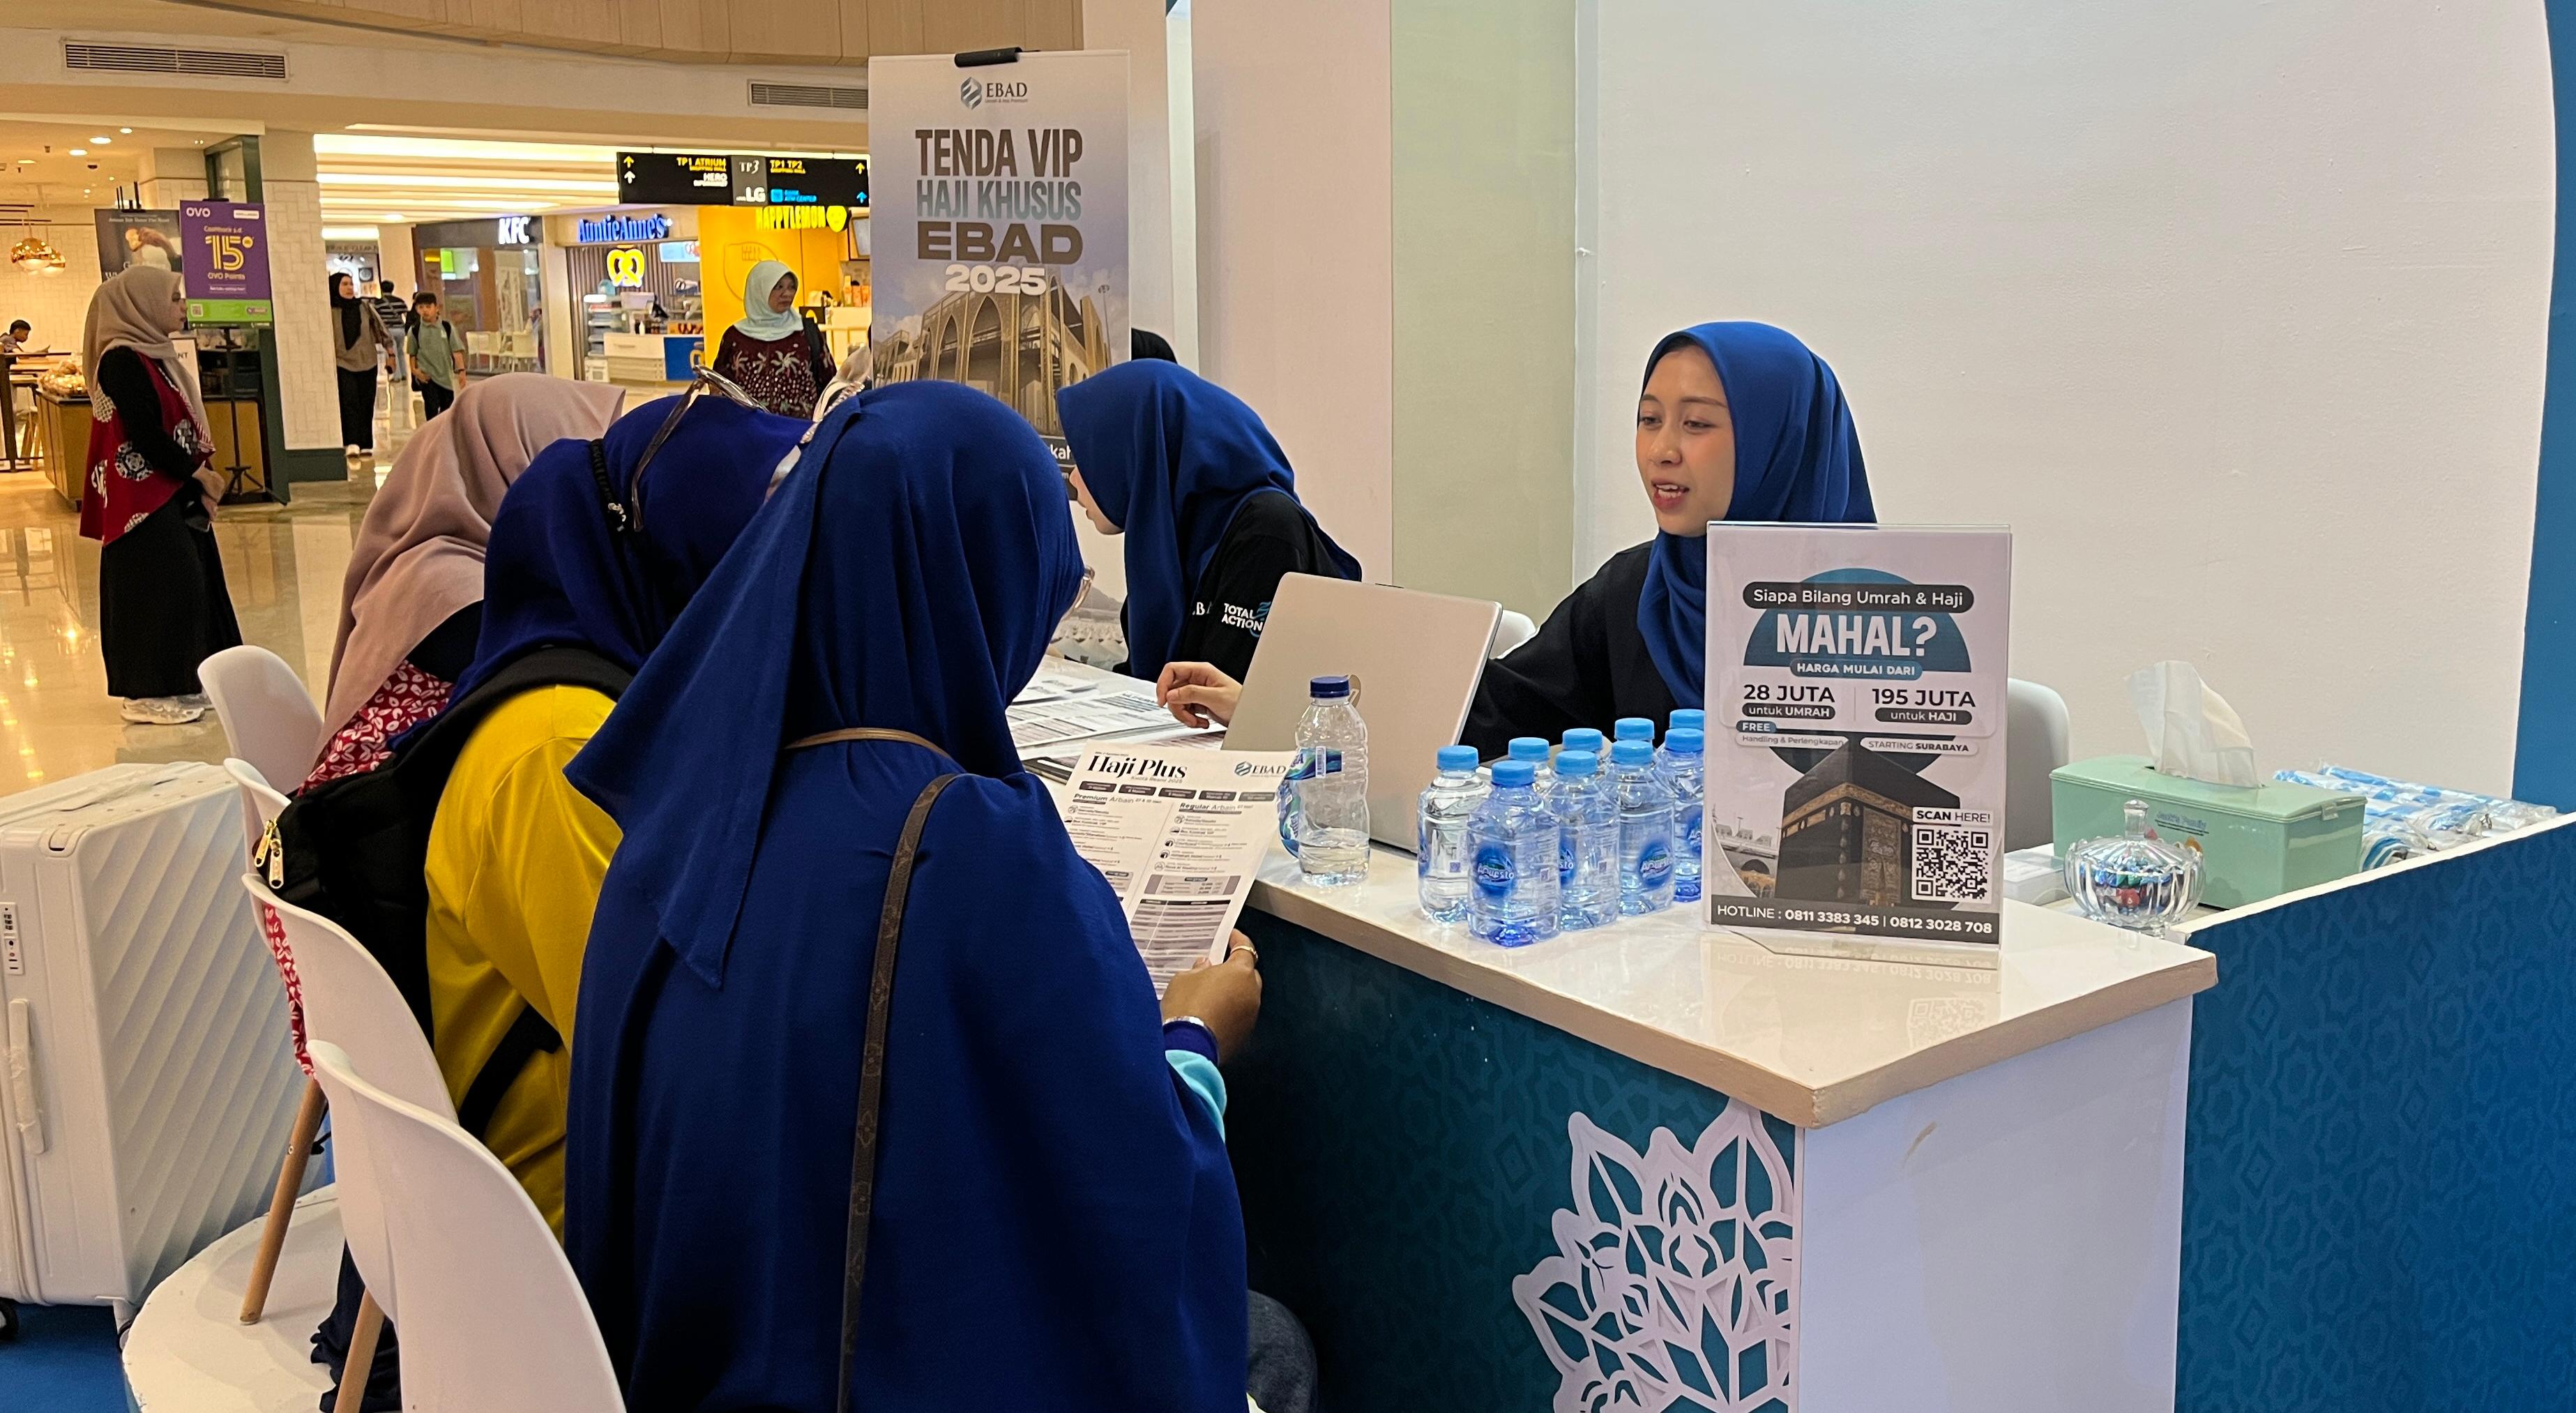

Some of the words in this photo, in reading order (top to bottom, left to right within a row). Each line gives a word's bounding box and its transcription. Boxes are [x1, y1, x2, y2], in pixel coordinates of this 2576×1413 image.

[986, 82, 1028, 98] EBAD
[915, 128, 1018, 177] TENDA
[1028, 128, 1083, 178] VIP
[695, 158, 727, 166] ATRIUM
[739, 160, 759, 174] TP3
[770, 160, 785, 168] TP1
[787, 160, 803, 169] TP2
[745, 186, 766, 202] LG
[916, 179, 969, 218] HAJI
[977, 180, 1082, 221] KHUSUS
[186, 207, 211, 217] OVO
[499, 217, 531, 244] KFC
[917, 221, 1084, 264] EBAD
[945, 264, 1047, 296] 2025
[1753, 589, 1798, 605] Siapa
[1802, 590, 1851, 605] Bilang
[1857, 591, 1911, 605] Umrah
[1915, 593, 1927, 605] &
[1932, 593, 1964, 608] Haji
[1224, 603, 1255, 620] TOTAL
[1221, 614, 1264, 632] ACTION
[1777, 614, 1937, 657] MAHAL?
[1797, 663, 1840, 674] HARGA
[1843, 664, 1882, 675] MULAI
[1886, 665, 1915, 676] DARI
[1743, 684, 1770, 700] 28
[1776, 686, 1835, 703] JUTA
[1872, 688, 1909, 705] 195
[1915, 690, 1976, 708] JUTA
[1749, 706, 1782, 716] untuk
[1785, 707, 1830, 717] UMRAH
[1891, 711, 1925, 721] untuk
[1928, 712, 1957, 722] HAJI
[1742, 723, 1771, 732] FREE
[1742, 735, 1779, 744] Handling
[1788, 737, 1844, 746] Perlengkapan
[1869, 741, 1914, 750] STARTING
[1915, 743, 1969, 753] SURABAYA
[1088, 755, 1137, 778] Haji
[1137, 760, 1188, 778] Plus
[1252, 765, 1287, 774] EBAD
[1916, 810, 1951, 820] SCAN
[1955, 812, 1990, 823] HERE!
[1718, 905, 1775, 919] HOTLINE
[1785, 909, 1814, 921] 0811
[1817, 912, 1851, 924] 3383
[1854, 914, 1879, 926] 345
[1890, 916, 1923, 929] 0812
[1925, 919, 1962, 932] 3028
[1965, 921, 1992, 934] 708
